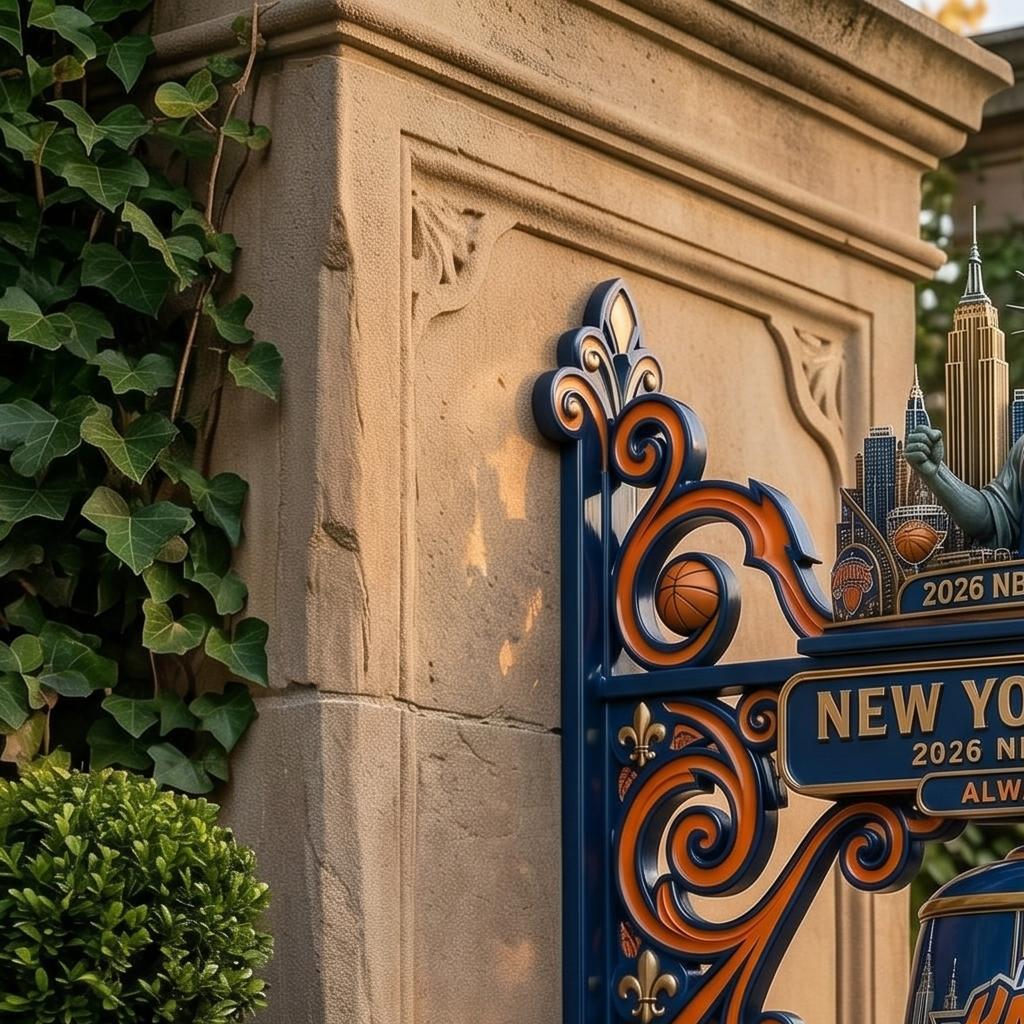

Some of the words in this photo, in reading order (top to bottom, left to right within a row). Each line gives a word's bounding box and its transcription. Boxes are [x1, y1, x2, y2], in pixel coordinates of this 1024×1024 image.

[922, 575, 985, 606] 2026
[816, 682, 944, 740] NEW
[911, 739, 981, 766] 2026
